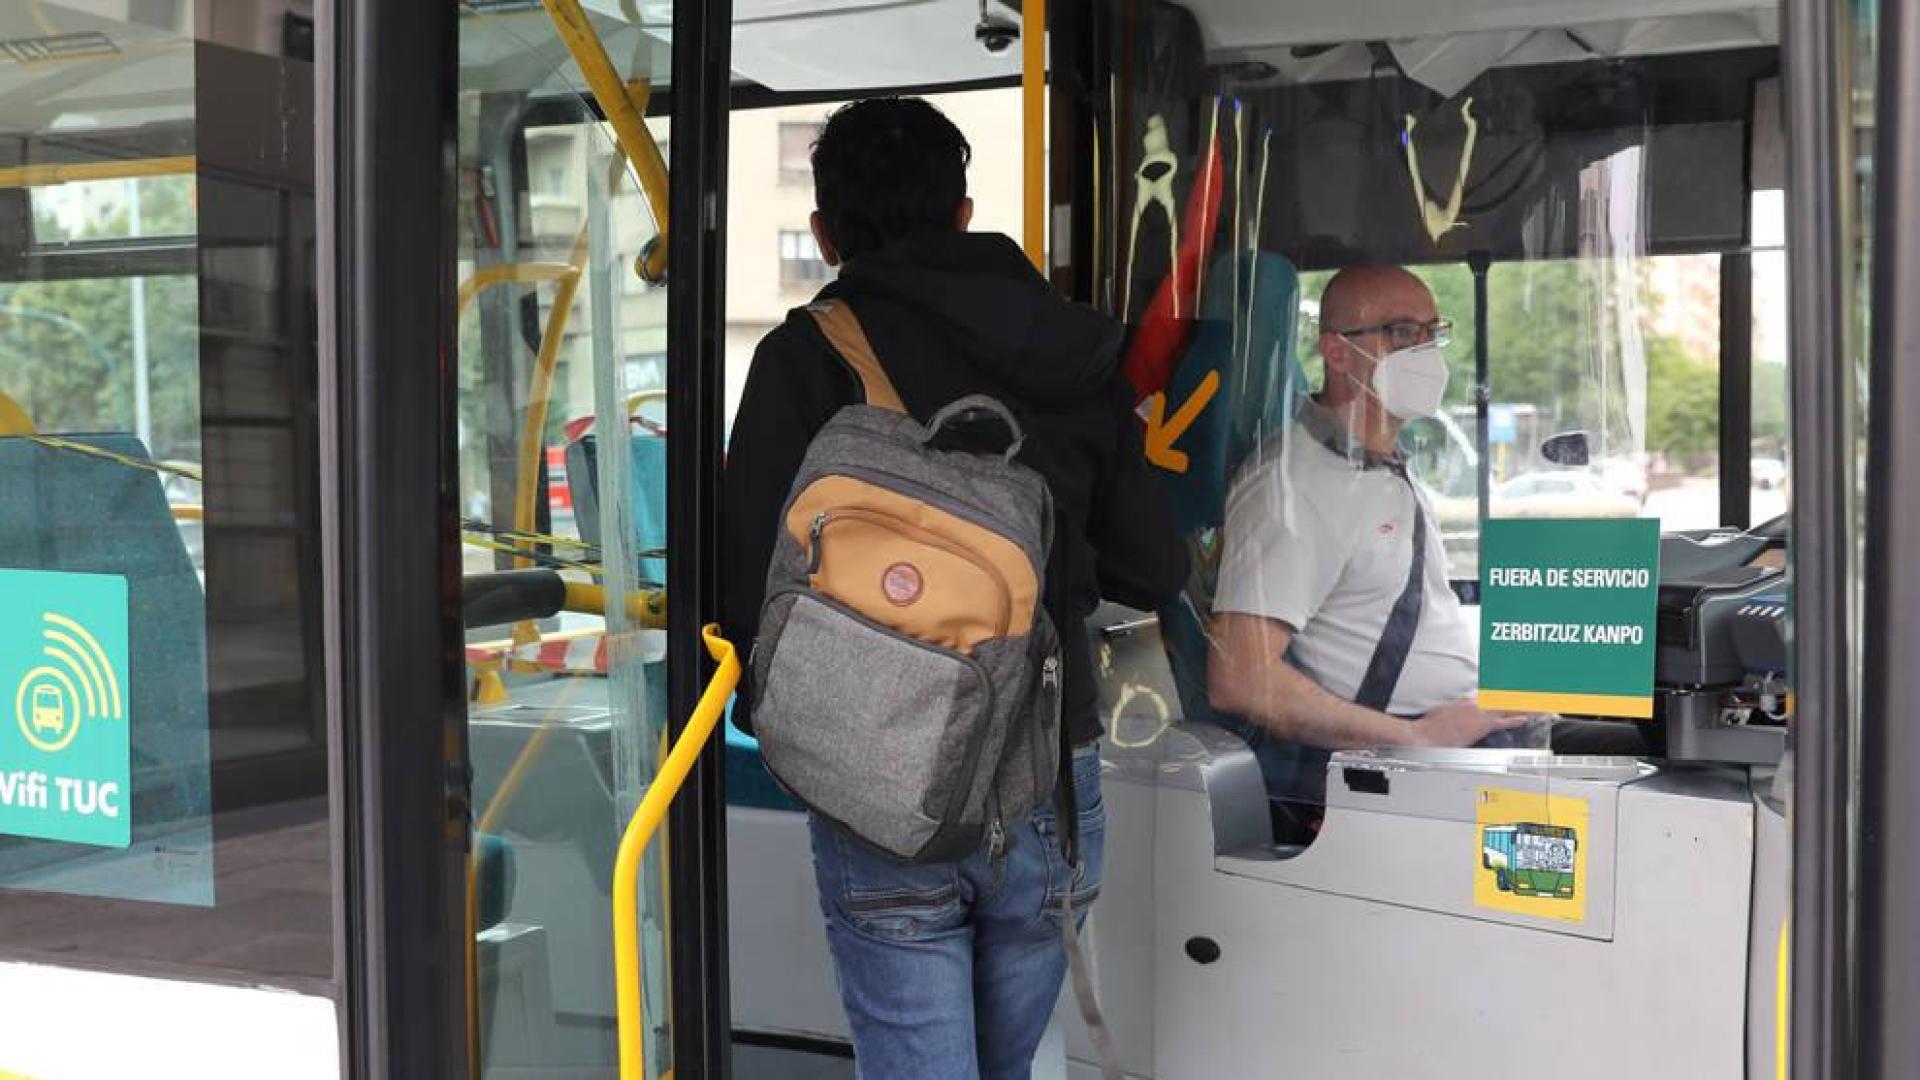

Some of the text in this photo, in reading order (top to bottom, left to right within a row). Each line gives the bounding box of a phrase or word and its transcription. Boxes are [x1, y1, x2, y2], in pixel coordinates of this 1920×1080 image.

[1489, 567, 1649, 588] FUERA DE SERVICIO
[1490, 622, 1643, 645] ZERBITZUZ KANPO
[55, 776, 119, 817] TUC
